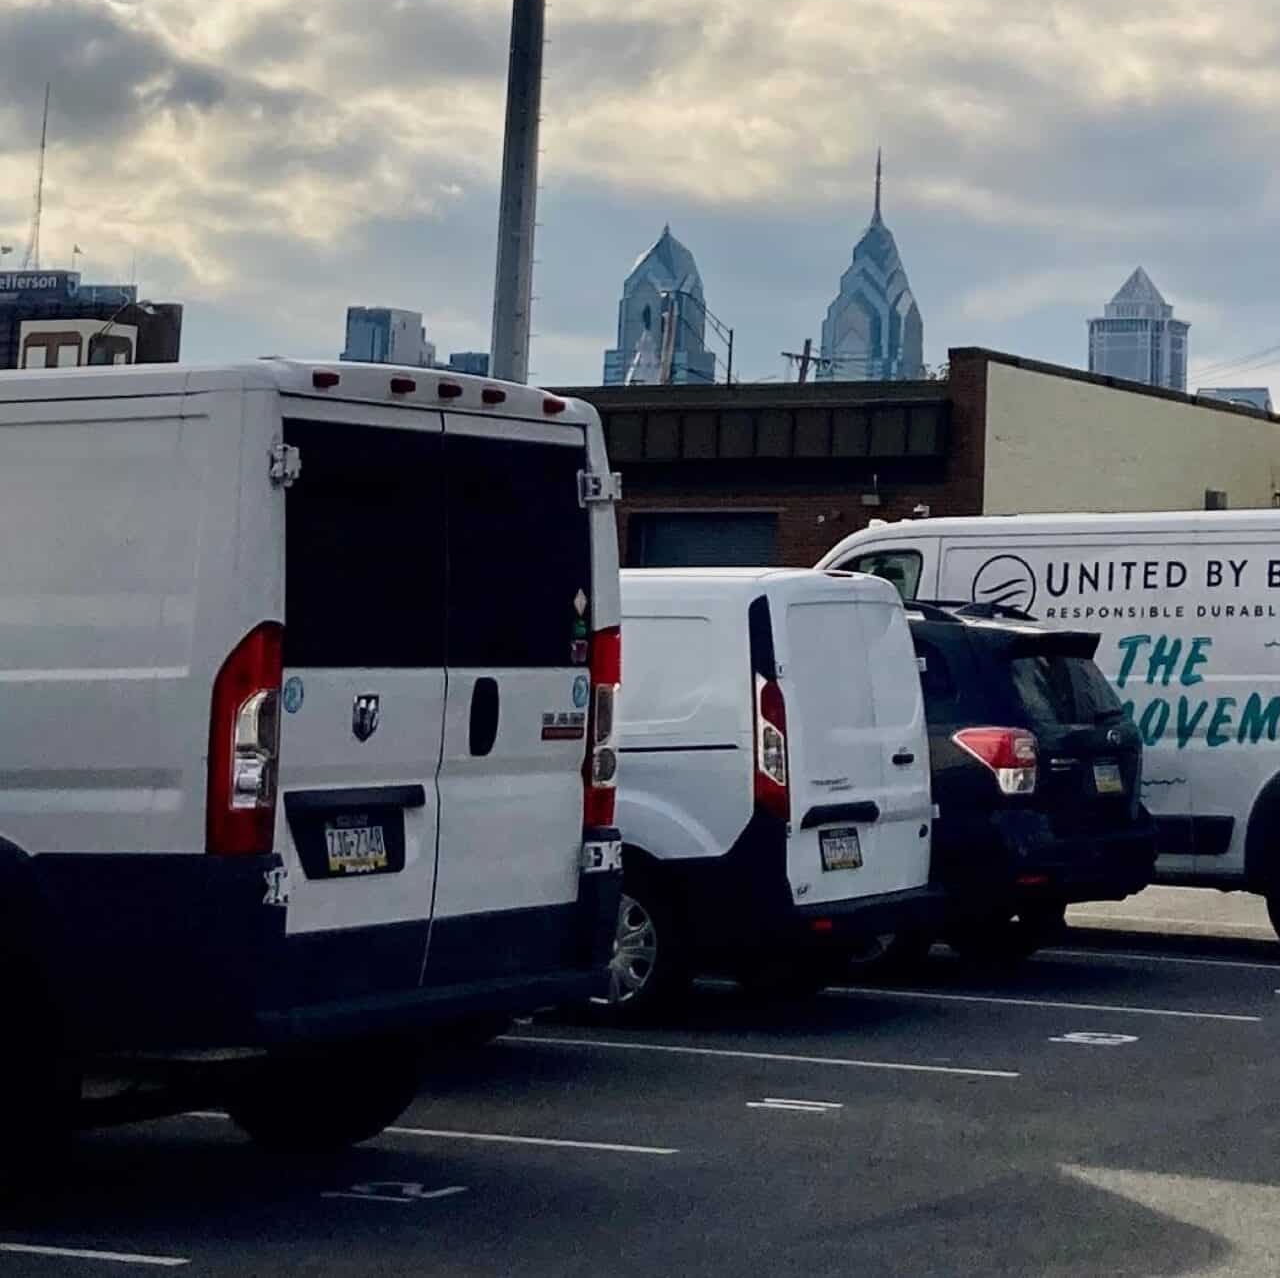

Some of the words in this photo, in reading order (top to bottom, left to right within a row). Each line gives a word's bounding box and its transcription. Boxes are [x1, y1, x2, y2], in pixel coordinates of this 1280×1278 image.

[1046, 560, 1188, 597] UNITED
[1206, 559, 1249, 589] BY
[1046, 606, 1185, 619] RESPONSIBLE
[1117, 633, 1213, 689] THE
